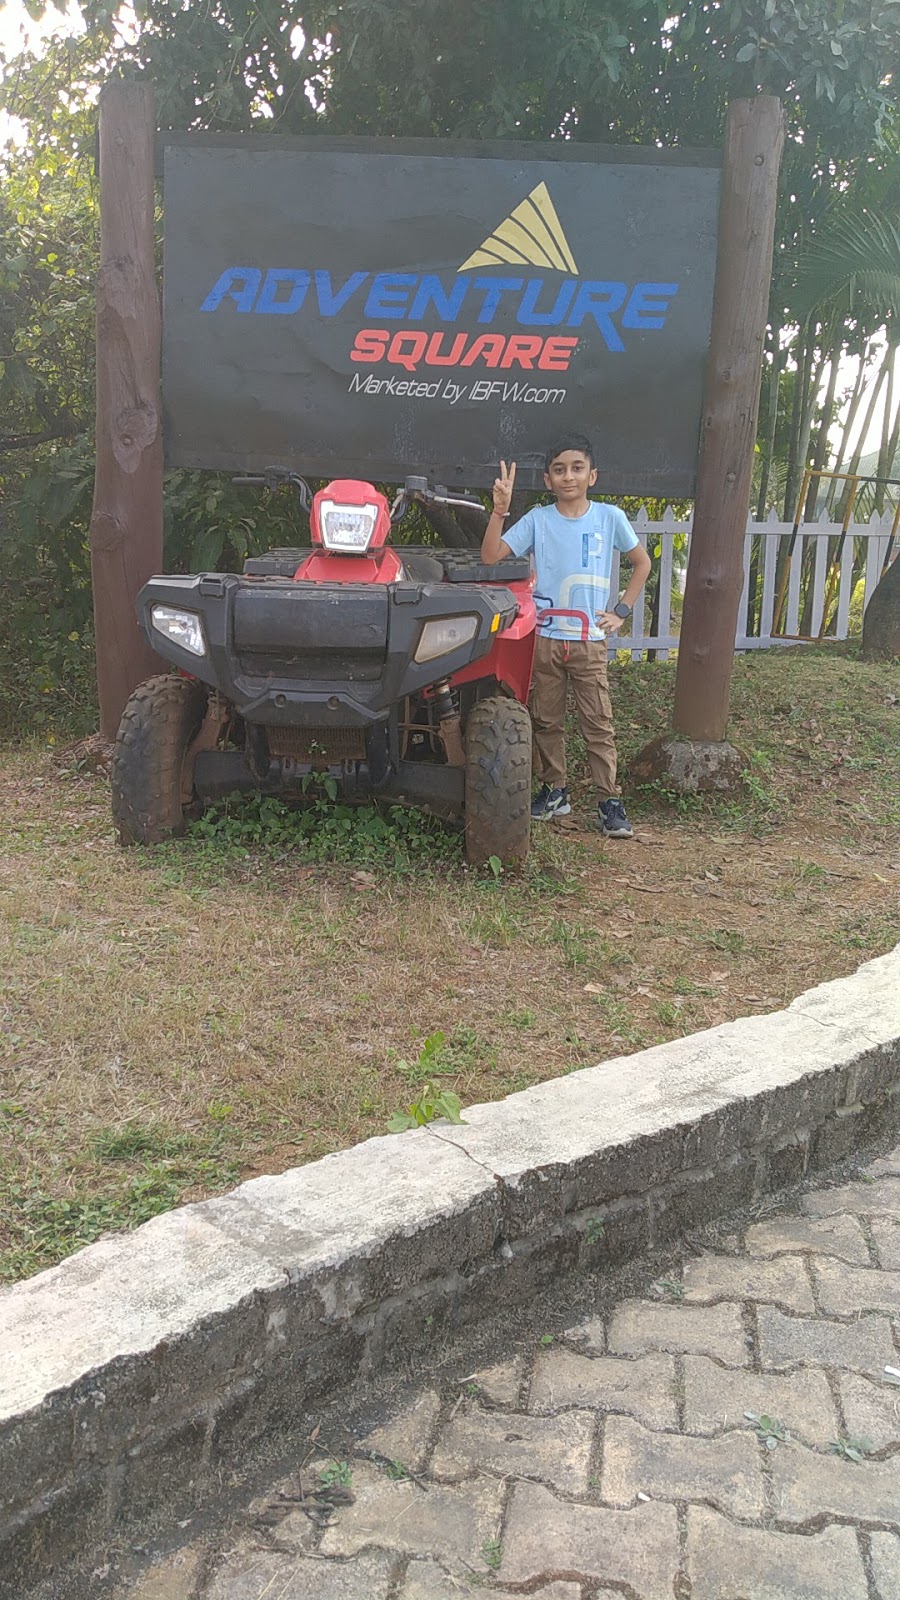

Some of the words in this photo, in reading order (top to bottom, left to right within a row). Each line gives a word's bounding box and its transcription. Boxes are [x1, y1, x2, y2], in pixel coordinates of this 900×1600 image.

[200, 266, 679, 352] ADVENTURE
[350, 329, 578, 371] SQUARE
[348, 373, 443, 398] Marketed
[442, 379, 467, 404] by
[468, 380, 566, 404] IBFW.com
